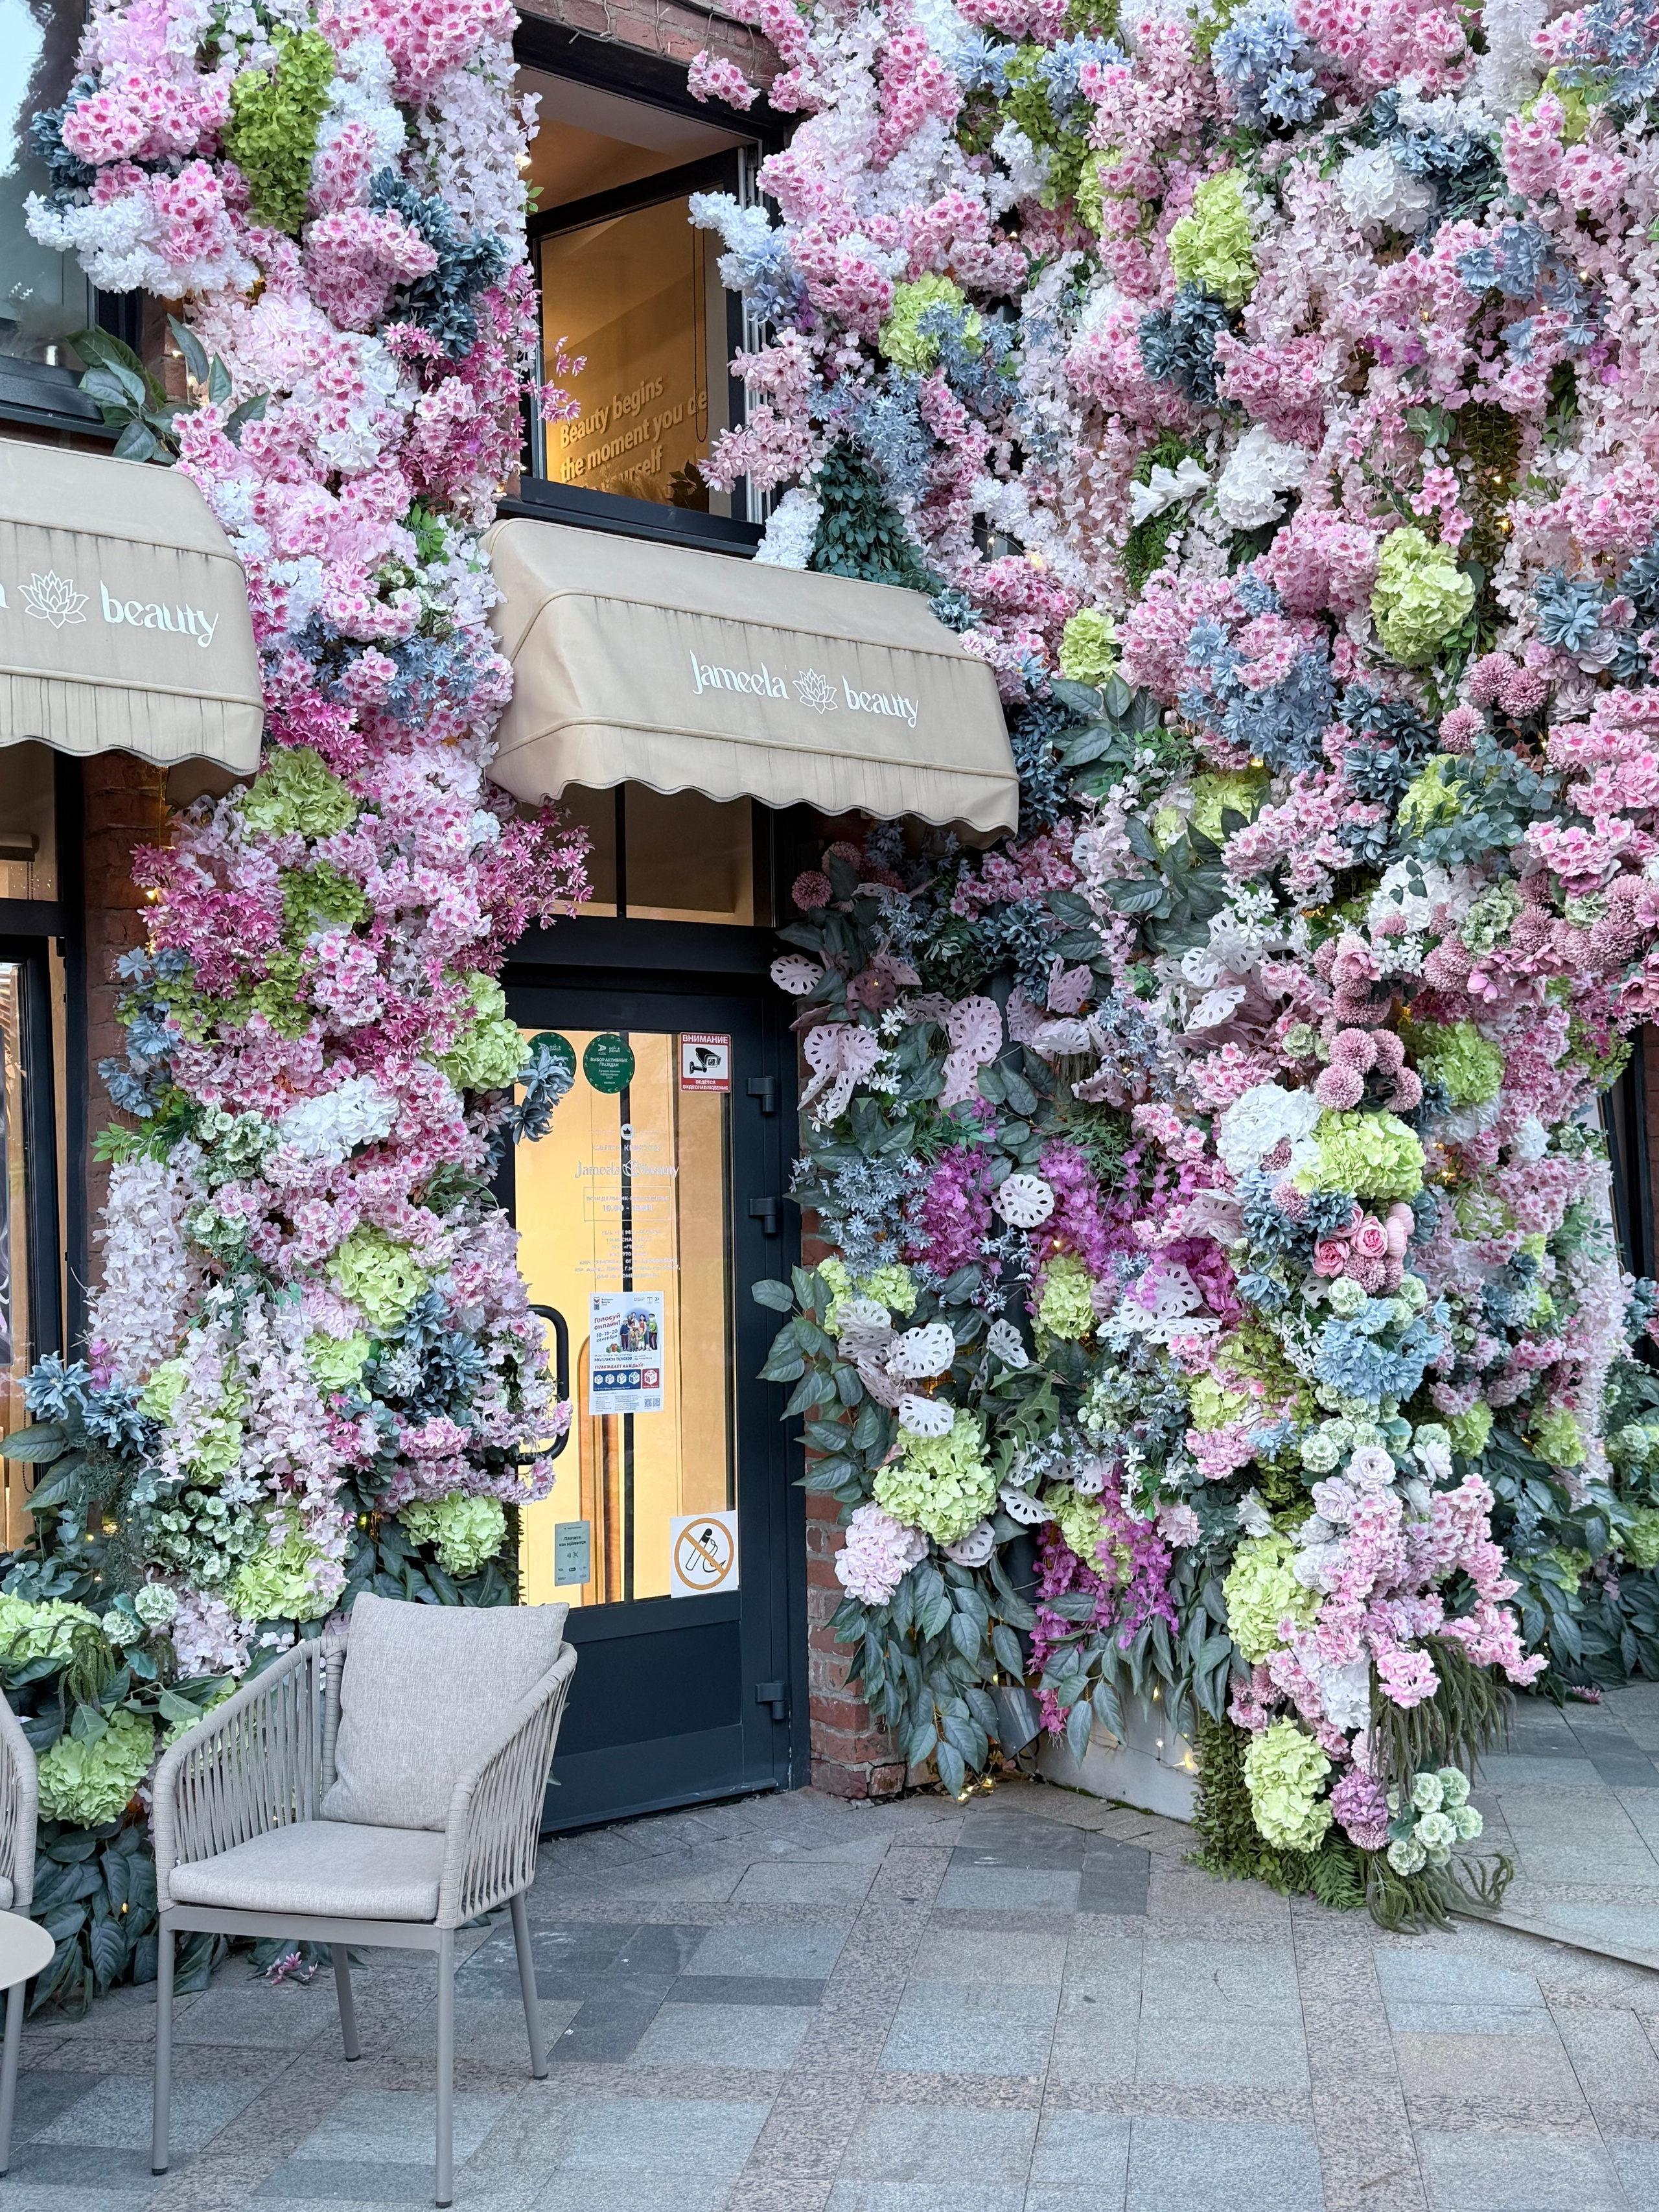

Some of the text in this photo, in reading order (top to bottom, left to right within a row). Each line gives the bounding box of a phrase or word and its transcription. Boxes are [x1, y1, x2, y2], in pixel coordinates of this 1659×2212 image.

[560, 377, 663, 448] Beauty begins
[560, 456, 584, 482] the
[587, 421, 650, 470] moment
[653, 404, 682, 442] you
[100, 580, 219, 647] beauty
[689, 649, 919, 728] Jameela beauty
[682, 1034, 728, 1044] ВНИМАНИЕ
[594, 1312, 620, 1323] Голосуй
[594, 1320, 620, 1330] онлайн!
